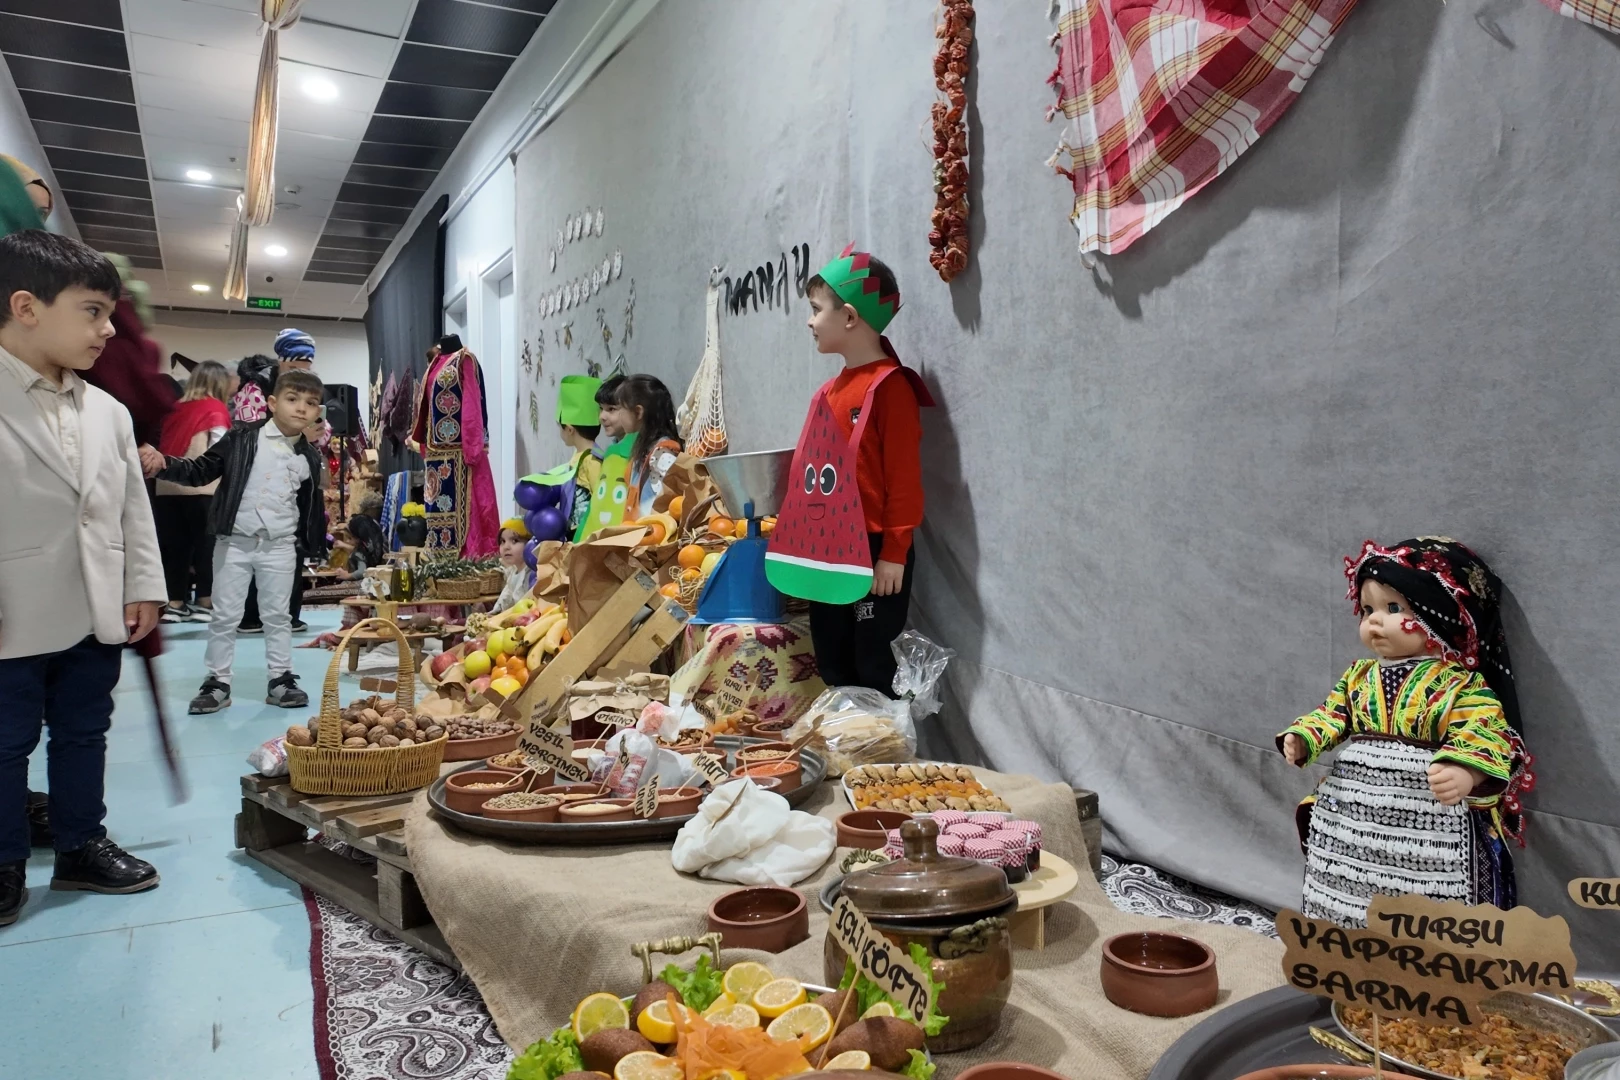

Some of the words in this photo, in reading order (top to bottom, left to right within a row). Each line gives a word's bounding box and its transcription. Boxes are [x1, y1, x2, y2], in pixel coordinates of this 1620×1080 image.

[258, 299, 281, 307] EXIT
[529, 722, 564, 750] YEŞİL
[518, 737, 587, 781] MERCİMEK
[1378, 911, 1505, 949] TURŞU
[835, 900, 867, 953] İÇLİ
[860, 936, 928, 1022] KÖFTE
[1290, 917, 1500, 991] YAPRAK
[1291, 962, 1473, 1026] SARMA
